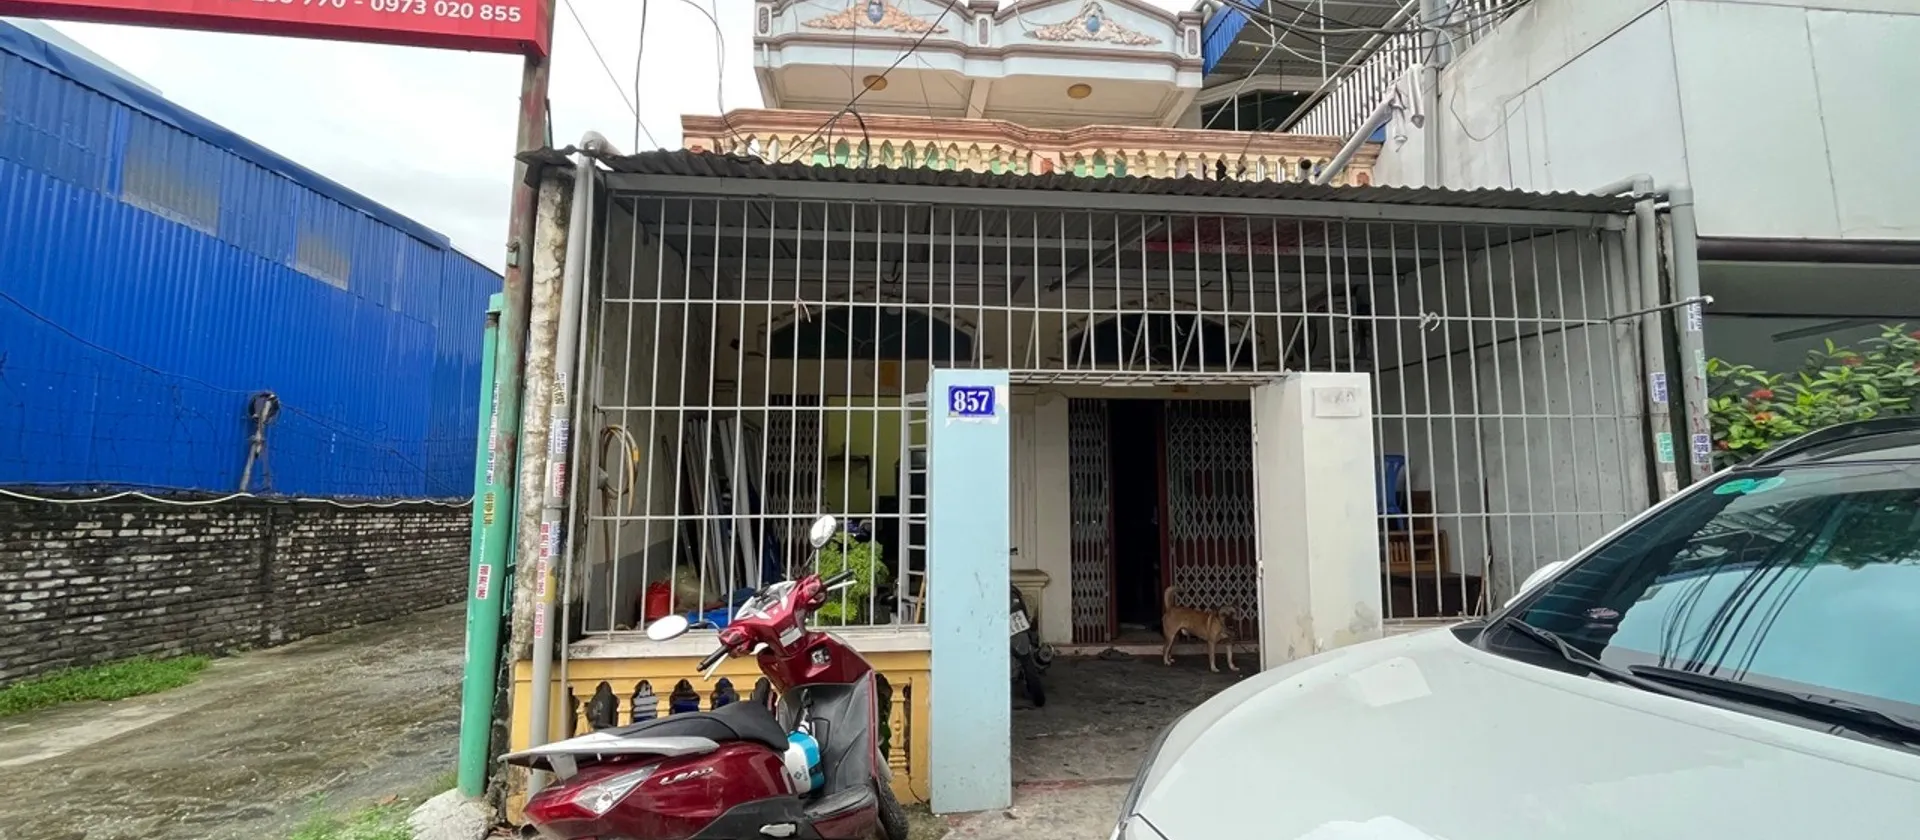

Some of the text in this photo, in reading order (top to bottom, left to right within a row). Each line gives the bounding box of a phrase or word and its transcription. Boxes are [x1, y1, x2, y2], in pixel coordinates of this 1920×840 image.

[370, 0, 426, 14] 0973
[434, 0, 474, 19] 020
[480, 4, 521, 22] 855
[954, 391, 990, 412] 857
